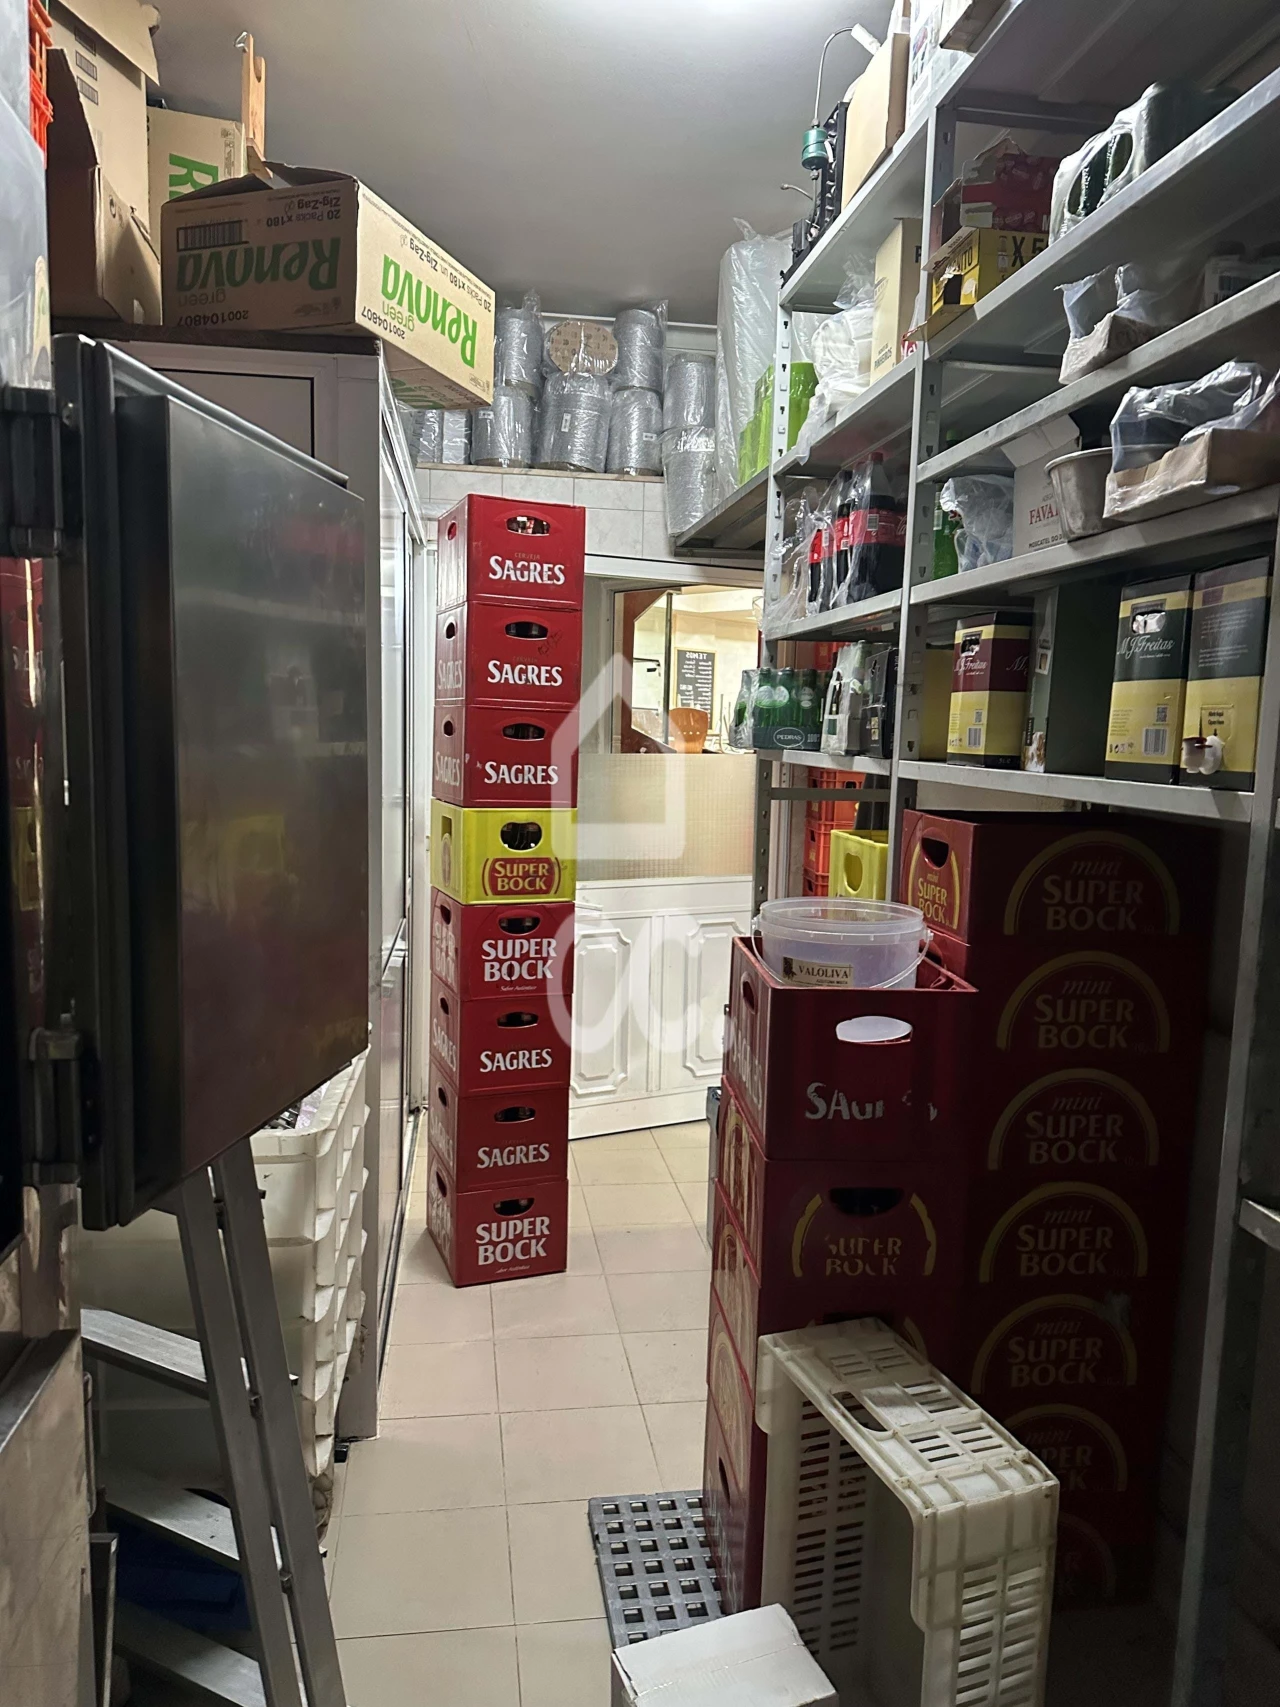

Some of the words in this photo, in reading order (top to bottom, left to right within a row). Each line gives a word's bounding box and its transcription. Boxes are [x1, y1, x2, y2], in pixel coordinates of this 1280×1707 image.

[296, 212, 324, 222] Packs
[327, 210, 340, 220] 20
[176, 236, 341, 292] Renova
[409, 237, 438, 272] Zig-Zag
[179, 287, 227, 307] green
[466, 284, 484, 307] Packs
[484, 298, 492, 313] 20
[177, 310, 249, 328] 200104807
[361, 305, 406, 340] 200104807
[381, 253, 478, 369] Renova
[382, 300, 415, 333] green
[1028, 537, 1050, 548] MOSCATEL
[488, 555, 566, 585] SAGRES
[487, 660, 563, 687] SAGRES
[434, 751, 460, 786] SAGRES
[484, 761, 559, 785] SAGRES
[494, 861, 550, 877] SUPER
[1070, 856, 1123, 876] mini
[497, 877, 548, 892] BOCK
[918, 878, 948, 906] SUPER
[1042, 874, 1144, 904] SUPER
[918, 898, 946, 924] BOCK
[1046, 906, 1138, 932] BOCK
[482, 938, 557, 960] SUPER
[484, 960, 554, 982] BOCK
[798, 965, 849, 979] VALOLIVA
[1062, 974, 1114, 996] mini
[1034, 994, 1134, 1023] SUPER
[1037, 1024, 1128, 1050] BOCK
[480, 1048, 552, 1073] SAGRES
[1050, 1092, 1104, 1112] mini
[1024, 1110, 1124, 1140] SUPER
[476, 1143, 550, 1169] SAGRES
[1028, 1140, 1119, 1165] BOCK
[1042, 1204, 1095, 1224] mini
[476, 1216, 550, 1245] SUPER
[1016, 1224, 1115, 1252] SUPER
[478, 1238, 547, 1266] BOCK
[1020, 1252, 1110, 1278] BOCK
[1034, 1316, 1084, 1336] mini
[1008, 1336, 1104, 1363] SUPER
[1010, 1361, 1099, 1388] BOCK
